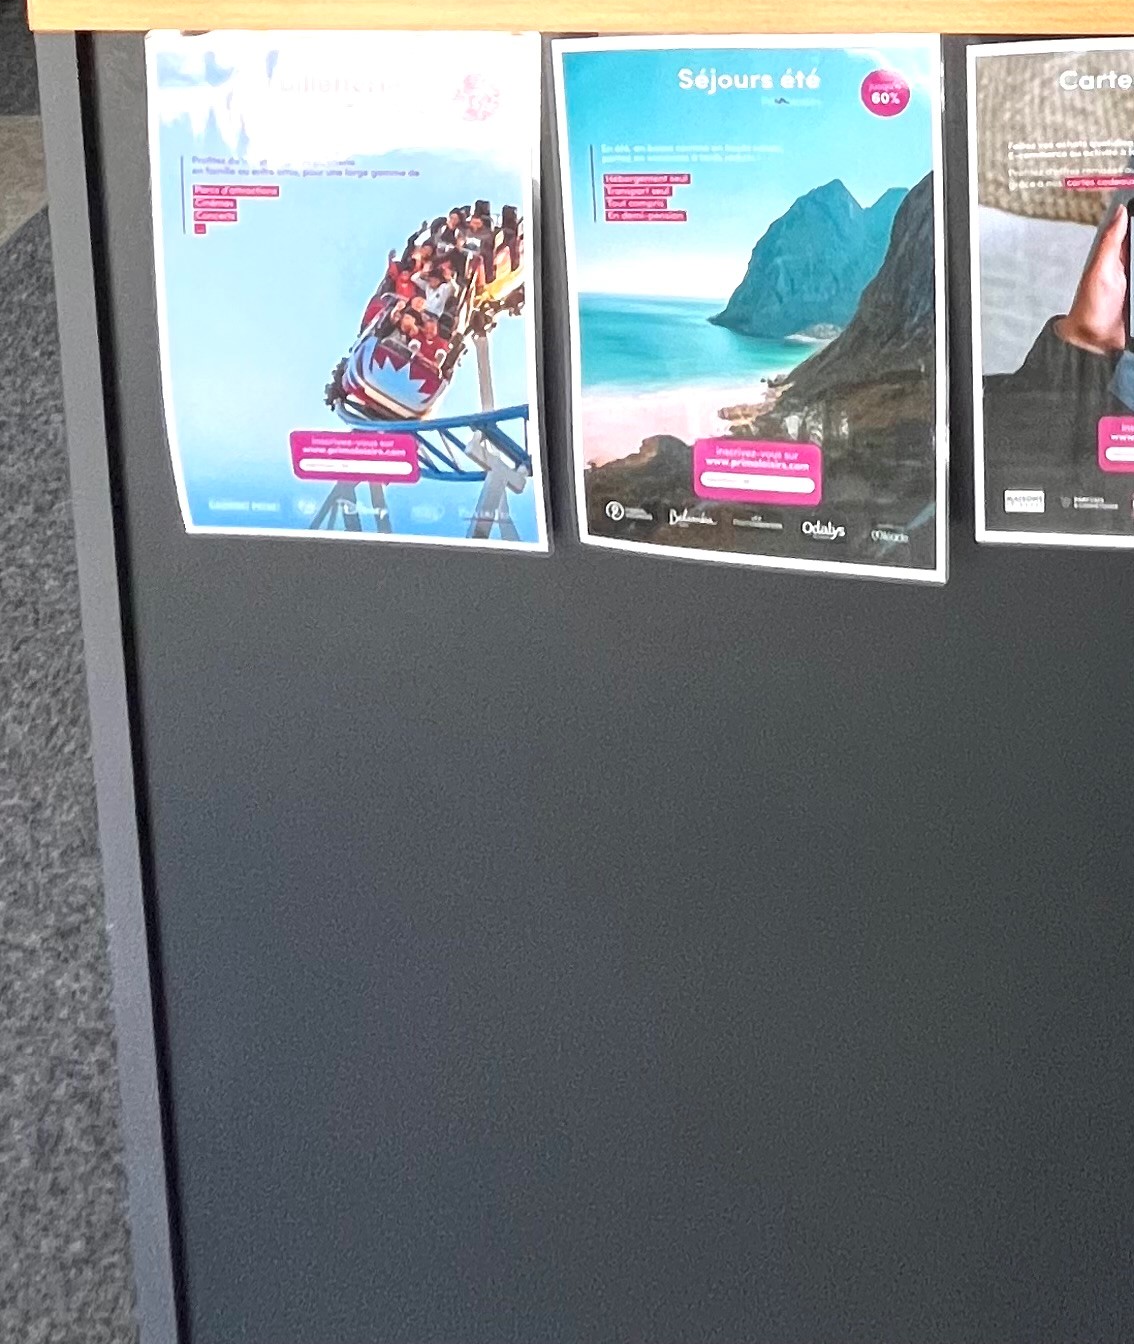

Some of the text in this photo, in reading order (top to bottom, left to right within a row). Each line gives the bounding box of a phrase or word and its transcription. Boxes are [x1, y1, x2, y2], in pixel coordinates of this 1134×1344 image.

[677, 67, 822, 95] Séjours été
[871, 91, 901, 105] 60%
[801, 519, 846, 541] Odalys
